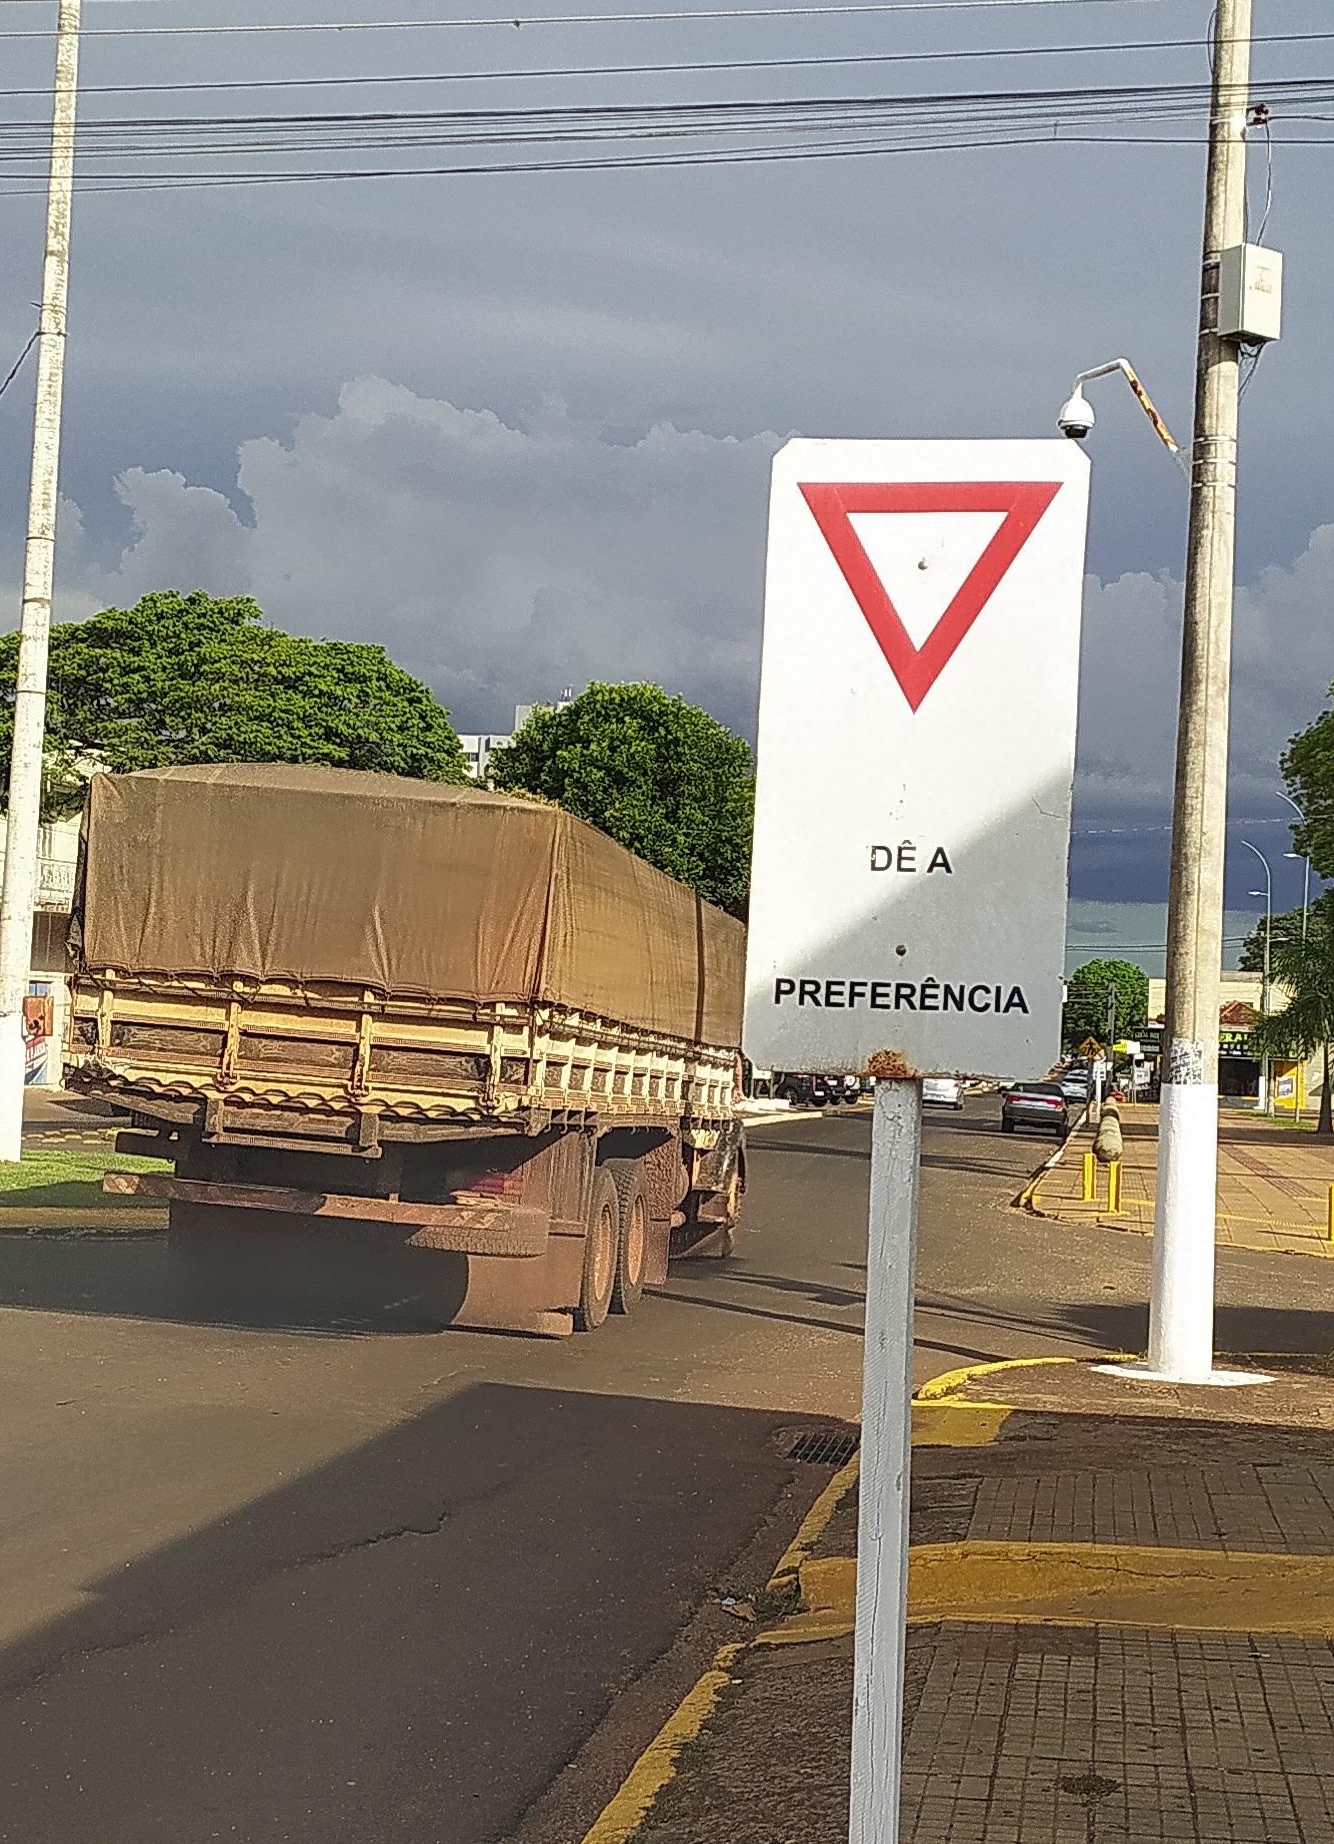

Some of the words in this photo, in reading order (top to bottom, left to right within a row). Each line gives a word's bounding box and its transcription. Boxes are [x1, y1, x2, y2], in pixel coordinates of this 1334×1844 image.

[870, 839, 916, 873] DÊ
[926, 846, 954, 875] A
[773, 976, 1031, 1015] PREFERÊNCIA
